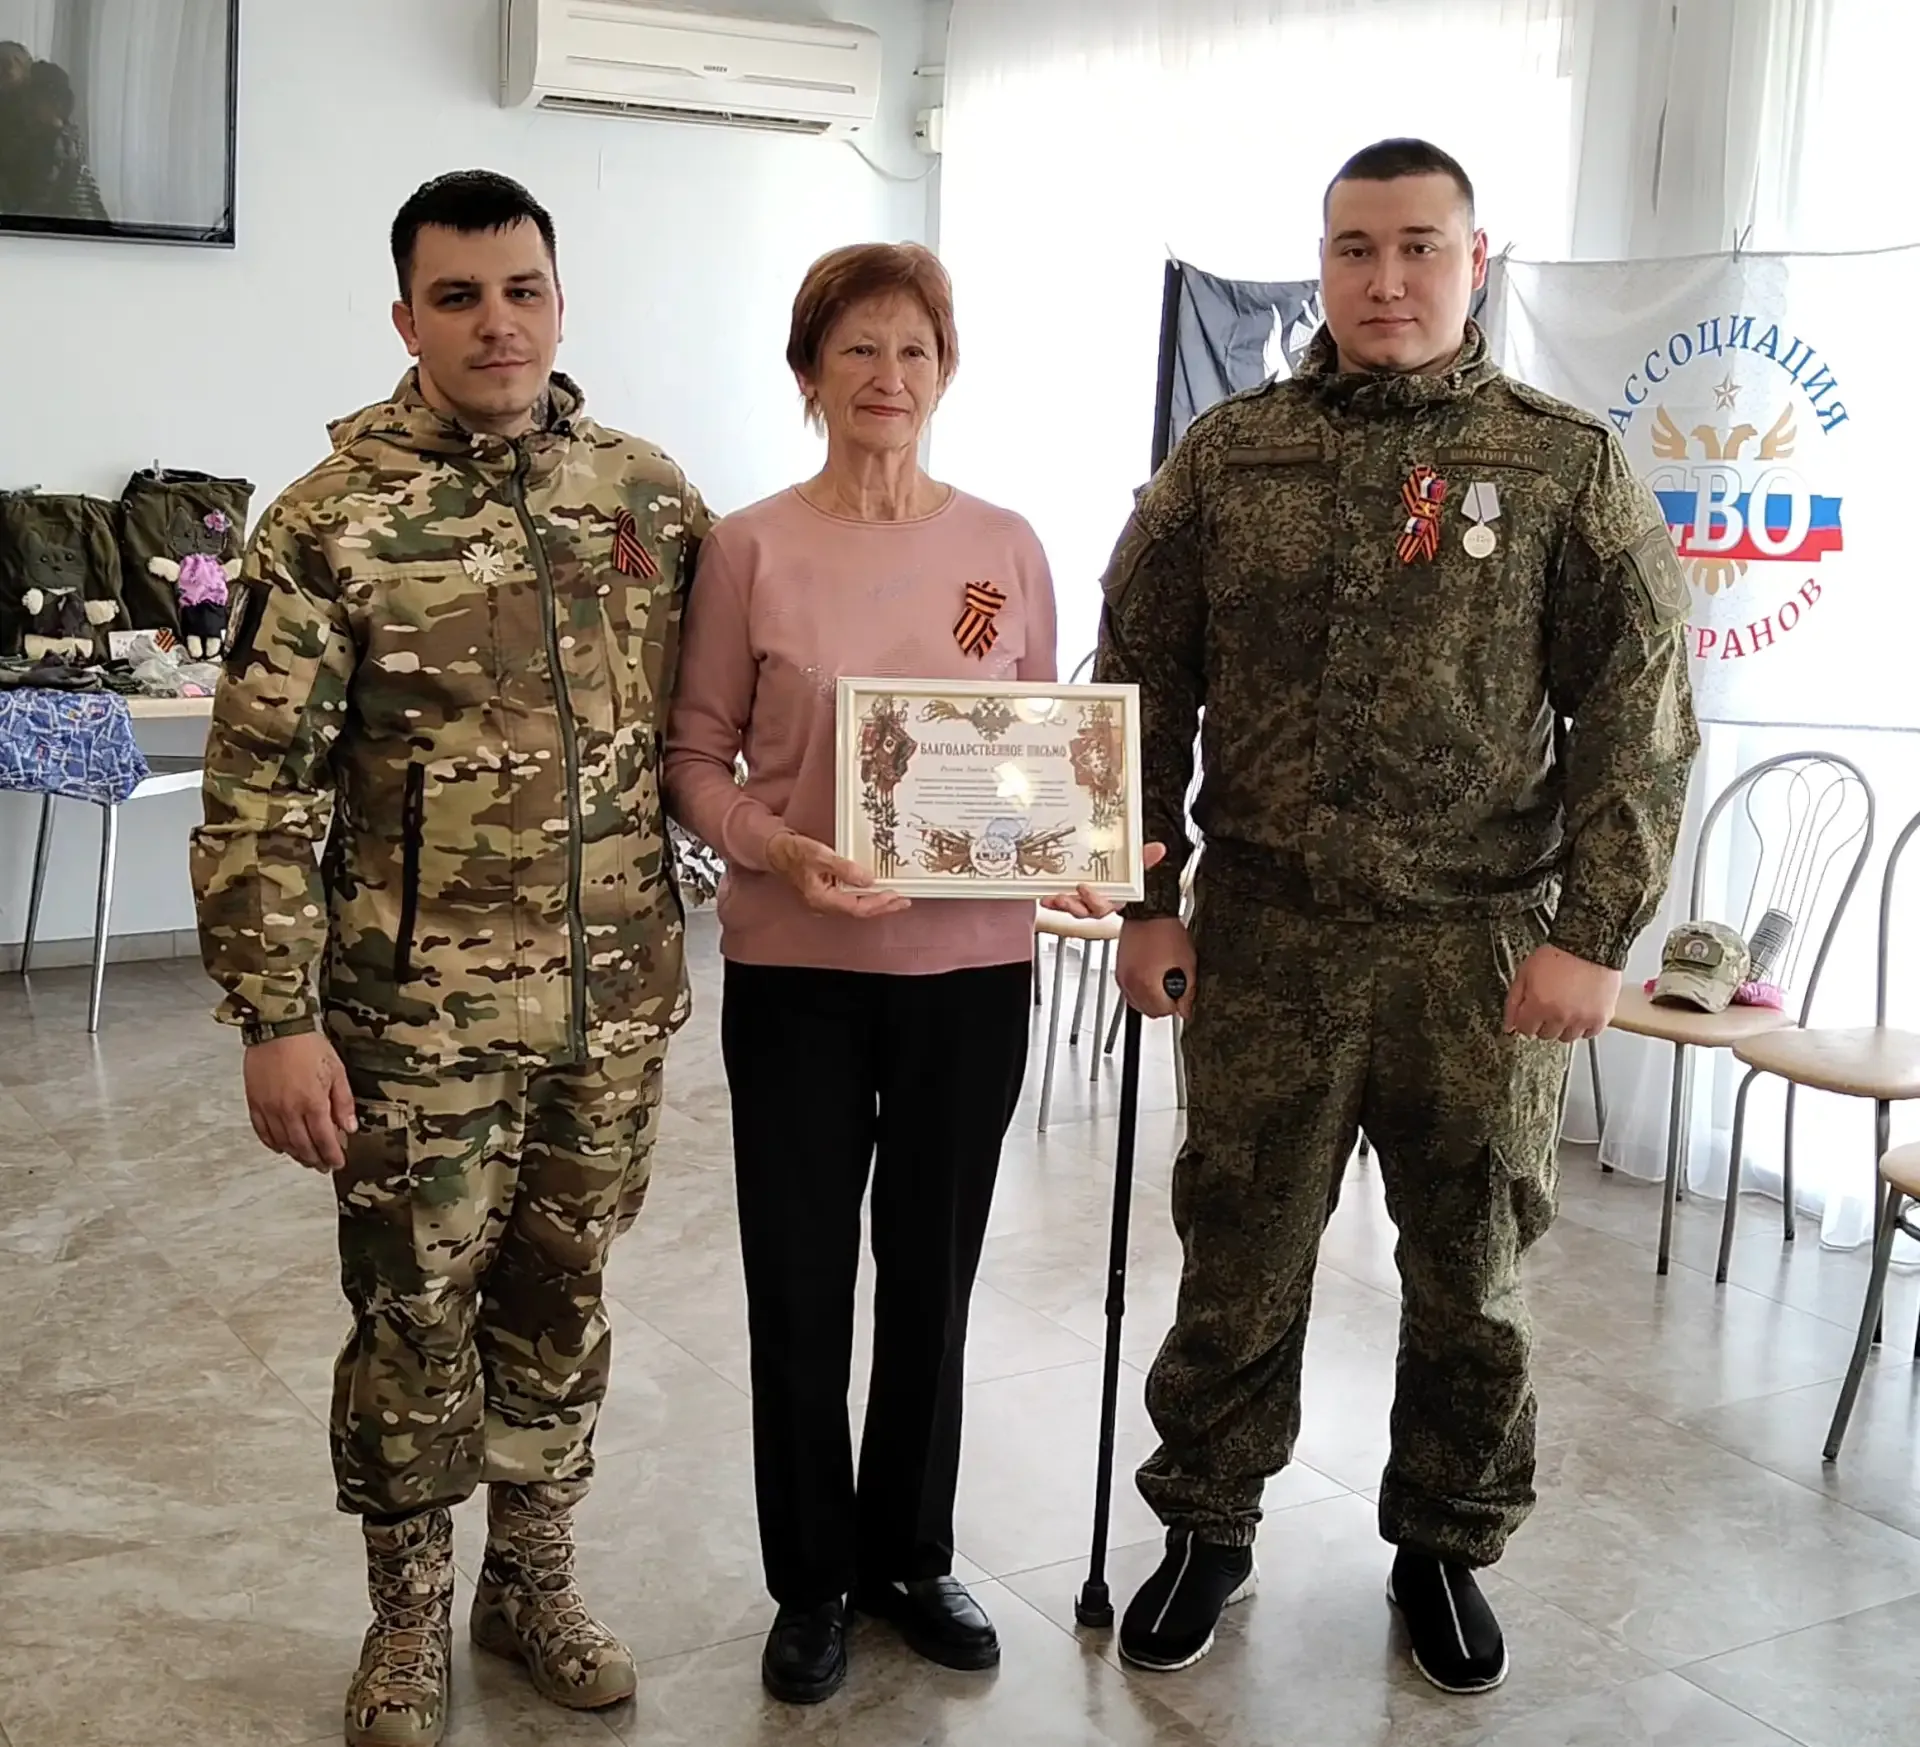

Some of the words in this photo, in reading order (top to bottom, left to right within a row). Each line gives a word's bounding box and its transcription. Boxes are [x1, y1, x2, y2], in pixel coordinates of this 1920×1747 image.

[1607, 315, 1850, 436] АССОЦИАЦИЯ
[1684, 578, 1822, 660] РАНОВ
[920, 742, 1024, 757] БЛАГОДАРСТВЕННОЕ
[1026, 744, 1067, 758] ПИСЬМО
